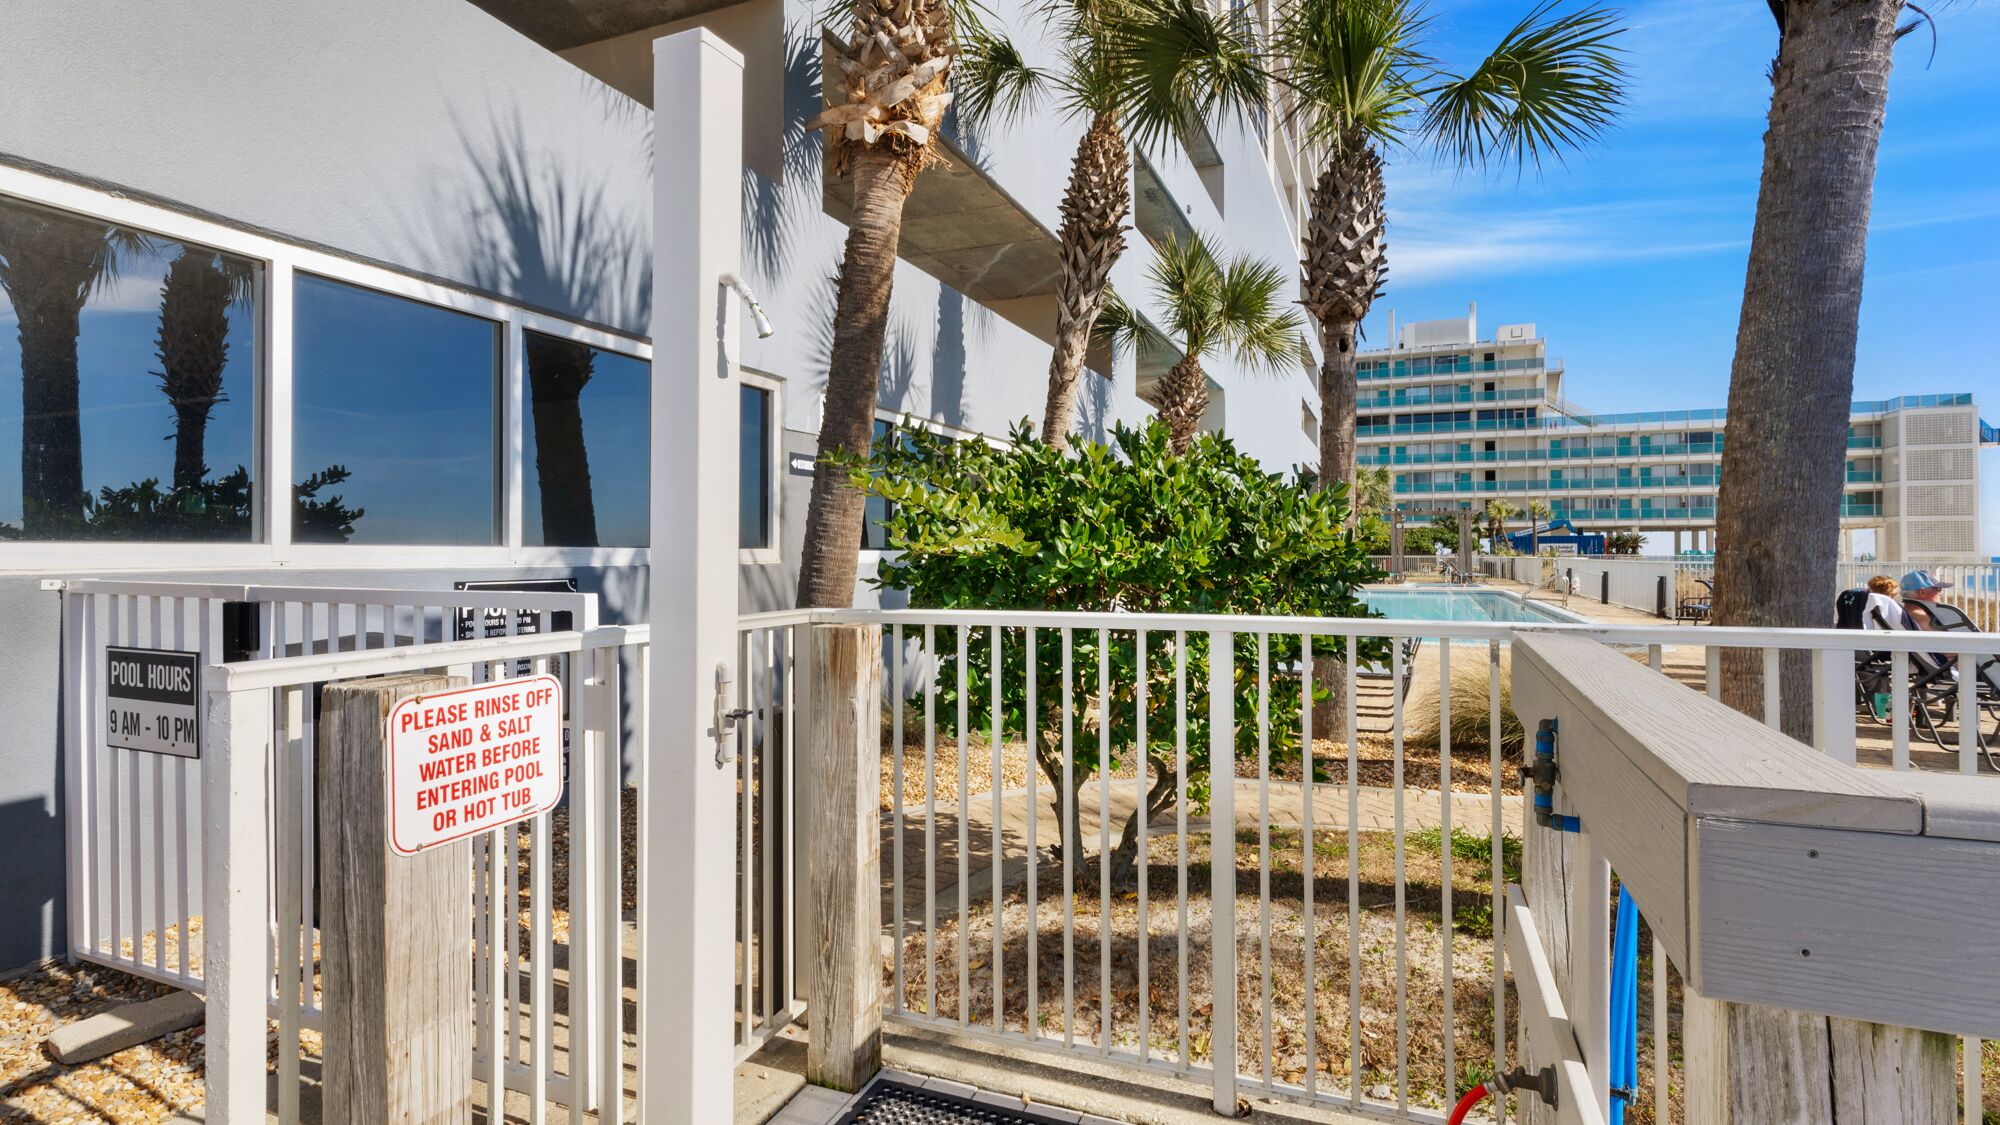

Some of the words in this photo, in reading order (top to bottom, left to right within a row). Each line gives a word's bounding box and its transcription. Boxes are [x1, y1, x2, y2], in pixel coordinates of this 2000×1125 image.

[111, 661, 144, 688] POOL
[147, 664, 191, 692] HOURS
[110, 709, 117, 733] 9
[121, 711, 140, 736] AM
[156, 714, 169, 740] 10
[174, 717, 195, 744] PM
[401, 703, 468, 733] PLEASE
[474, 694, 520, 718] RINSE
[526, 688, 553, 708] OFF
[428, 727, 473, 754] SAND
[480, 724, 491, 742] &
[498, 715, 533, 738] SALT
[419, 752, 477, 782] WATER
[482, 737, 541, 767] BEFORE
[416, 771, 499, 811] ENTERING
[504, 760, 544, 786] POOL
[433, 810, 457, 832] OR
[464, 797, 496, 824] HOT
[502, 787, 531, 811] TUB
